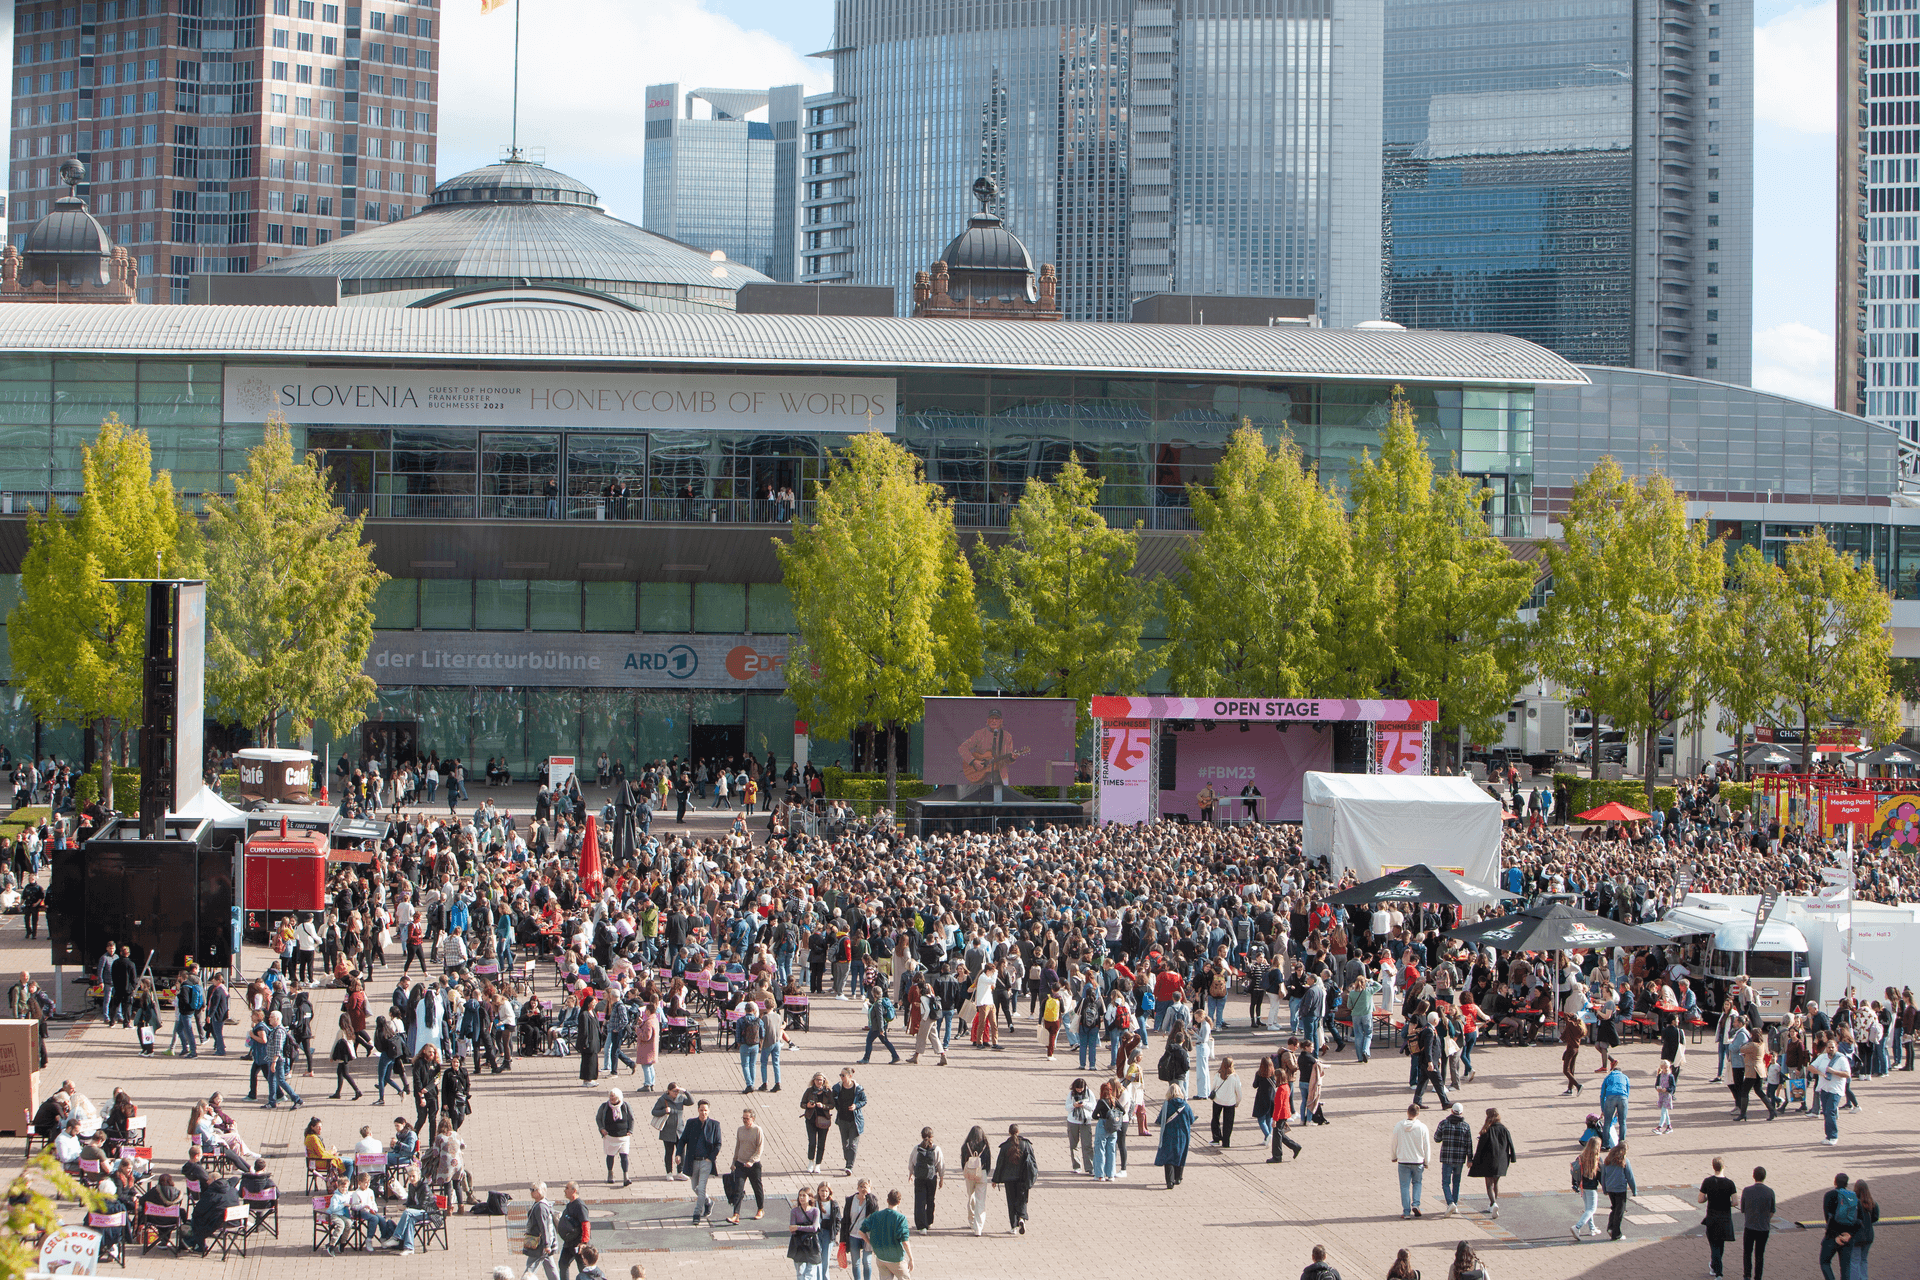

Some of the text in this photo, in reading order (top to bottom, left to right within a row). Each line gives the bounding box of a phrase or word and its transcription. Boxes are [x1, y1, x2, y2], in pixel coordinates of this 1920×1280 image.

[649, 98, 670, 108] Deka
[281, 384, 419, 408] SLOVENIA
[428, 386, 522, 395] GUEST OF HONOUR
[428, 394, 491, 402] FRANKFURTER
[483, 402, 505, 410] 2023
[530, 388, 885, 416] HONEYCOMB OF WORDS
[375, 649, 601, 671] der Literaturbühne
[624, 652, 668, 671] ARD
[1214, 702, 1319, 717] OPEN STAGE
[1103, 720, 1147, 728] BUCHMESSE
[1377, 723, 1420, 731] BUCHMESSE
[1101, 729, 1151, 768] 75
[1102, 727, 1110, 779] FRANKFURTER
[1376, 732, 1423, 770] 75
[241, 764, 264, 785] Café
[1198, 766, 1256, 779] #FBM23
[1830, 799, 1855, 807] Meeting
